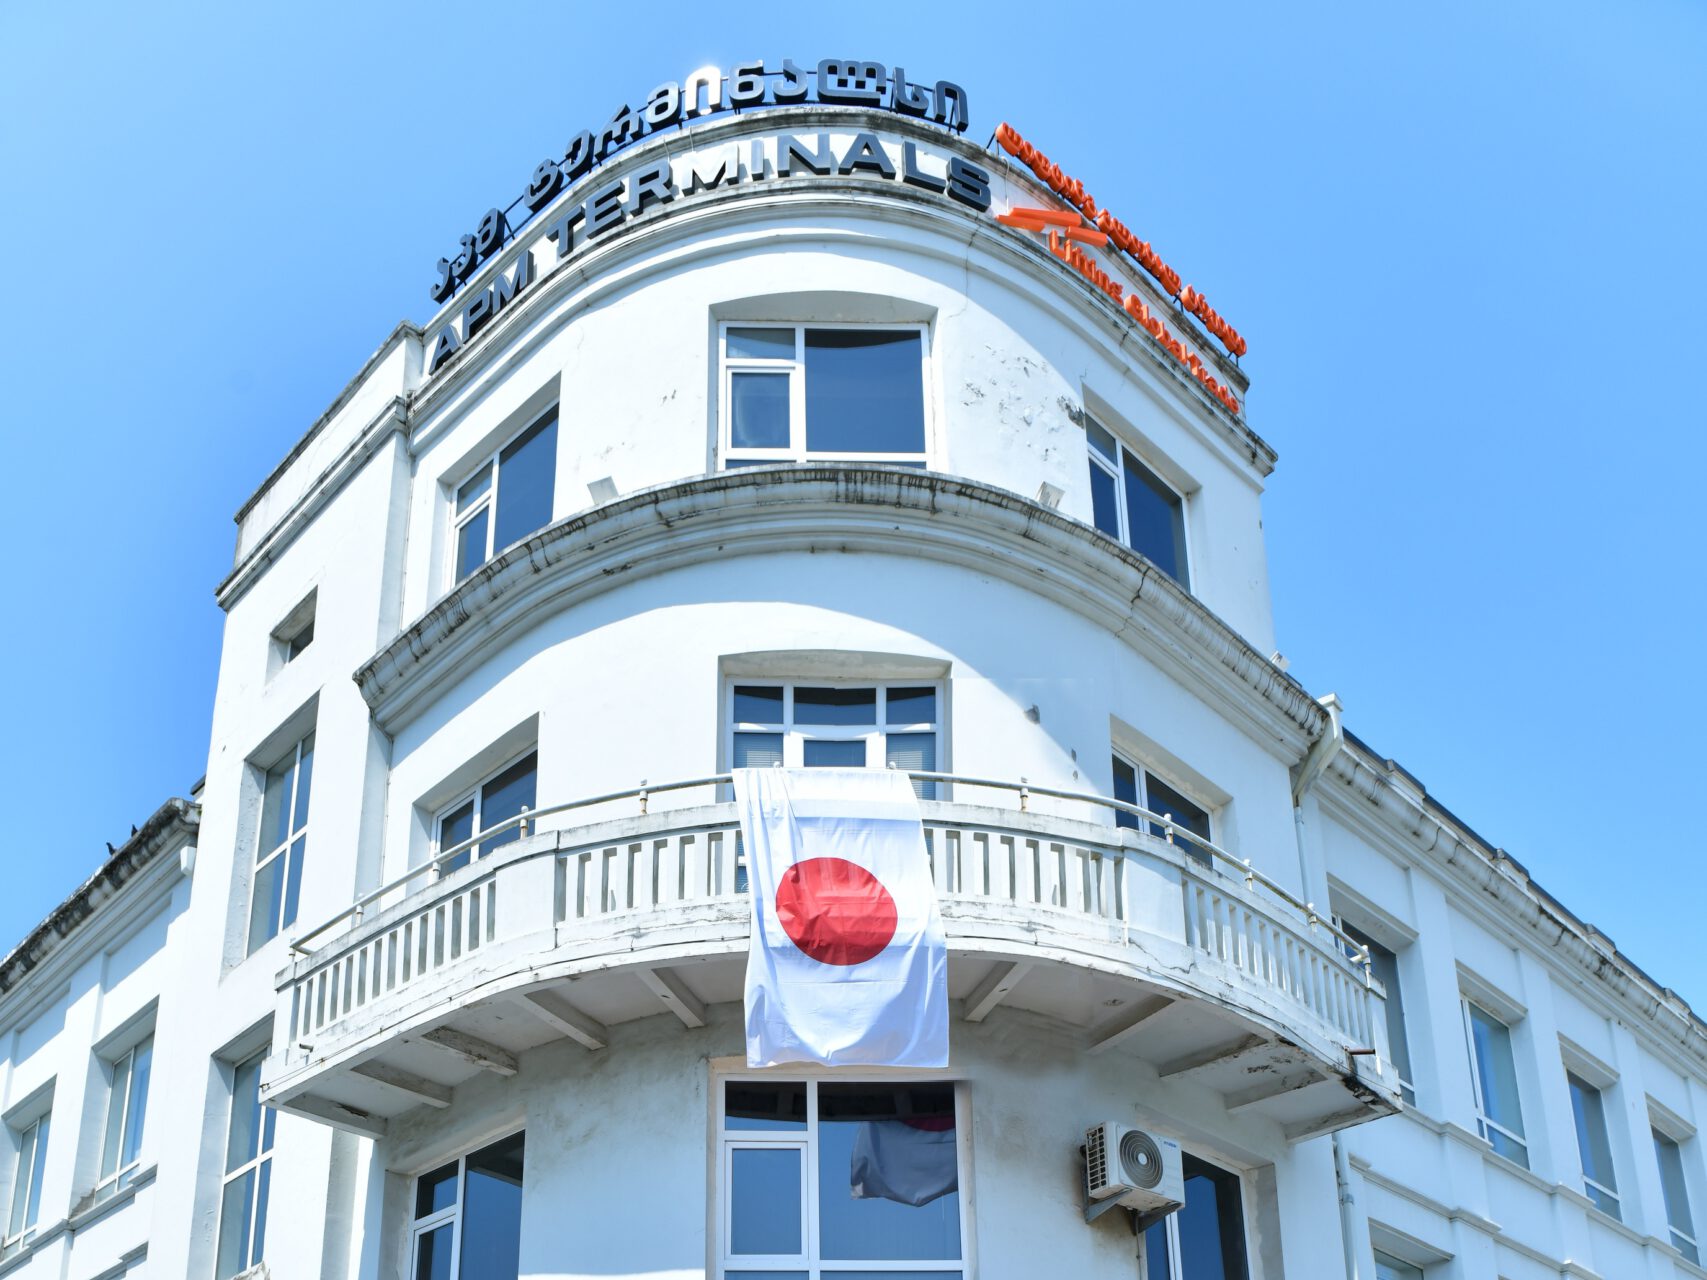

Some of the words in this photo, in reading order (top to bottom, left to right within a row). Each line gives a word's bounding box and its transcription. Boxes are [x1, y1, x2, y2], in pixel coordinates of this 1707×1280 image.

[428, 250, 534, 376] APM
[546, 132, 992, 259] TERMINALS
[1048, 229, 1125, 306] Lifting
[1124, 294, 1189, 367] Global
[1188, 351, 1241, 415] Trade
